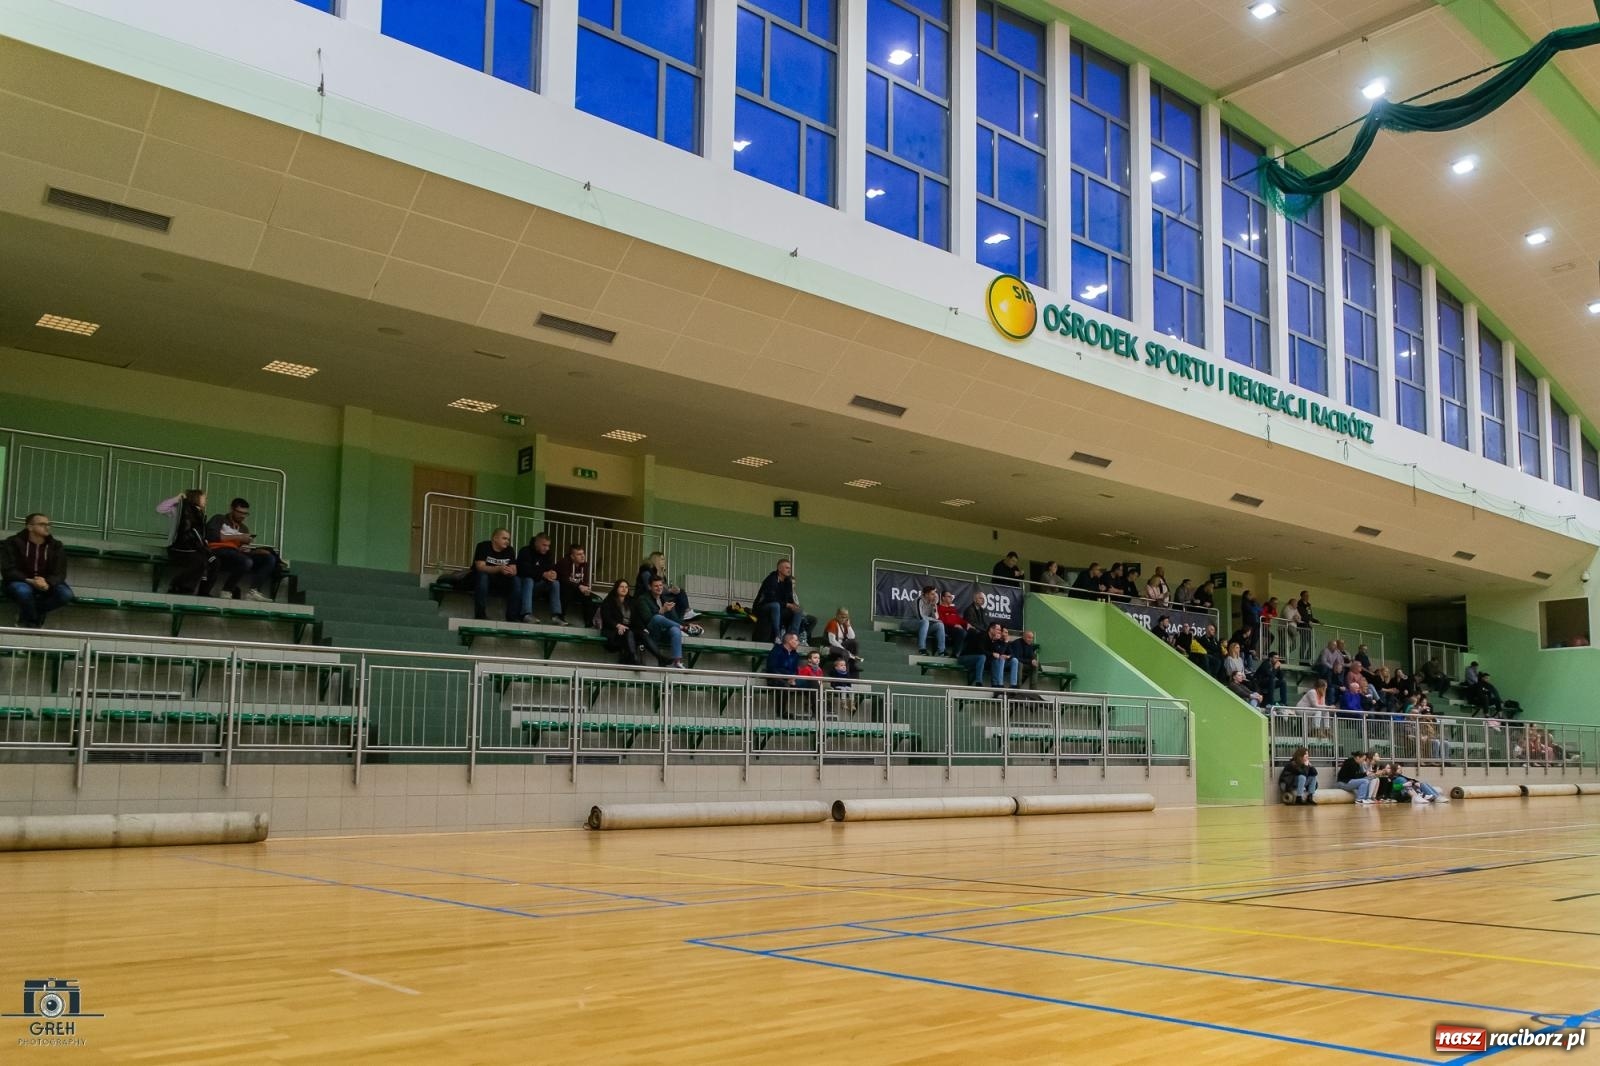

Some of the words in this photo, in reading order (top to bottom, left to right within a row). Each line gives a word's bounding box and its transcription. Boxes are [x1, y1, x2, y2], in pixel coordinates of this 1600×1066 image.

[1043, 303, 1140, 362] OŚRODEK
[1145, 341, 1215, 387] SPORTU
[1218, 367, 1224, 391] I
[1228, 371, 1307, 420] REKREACJI
[1311, 402, 1374, 444] RACIBÓRZ
[521, 456, 530, 470] E
[780, 506, 792, 516] E
